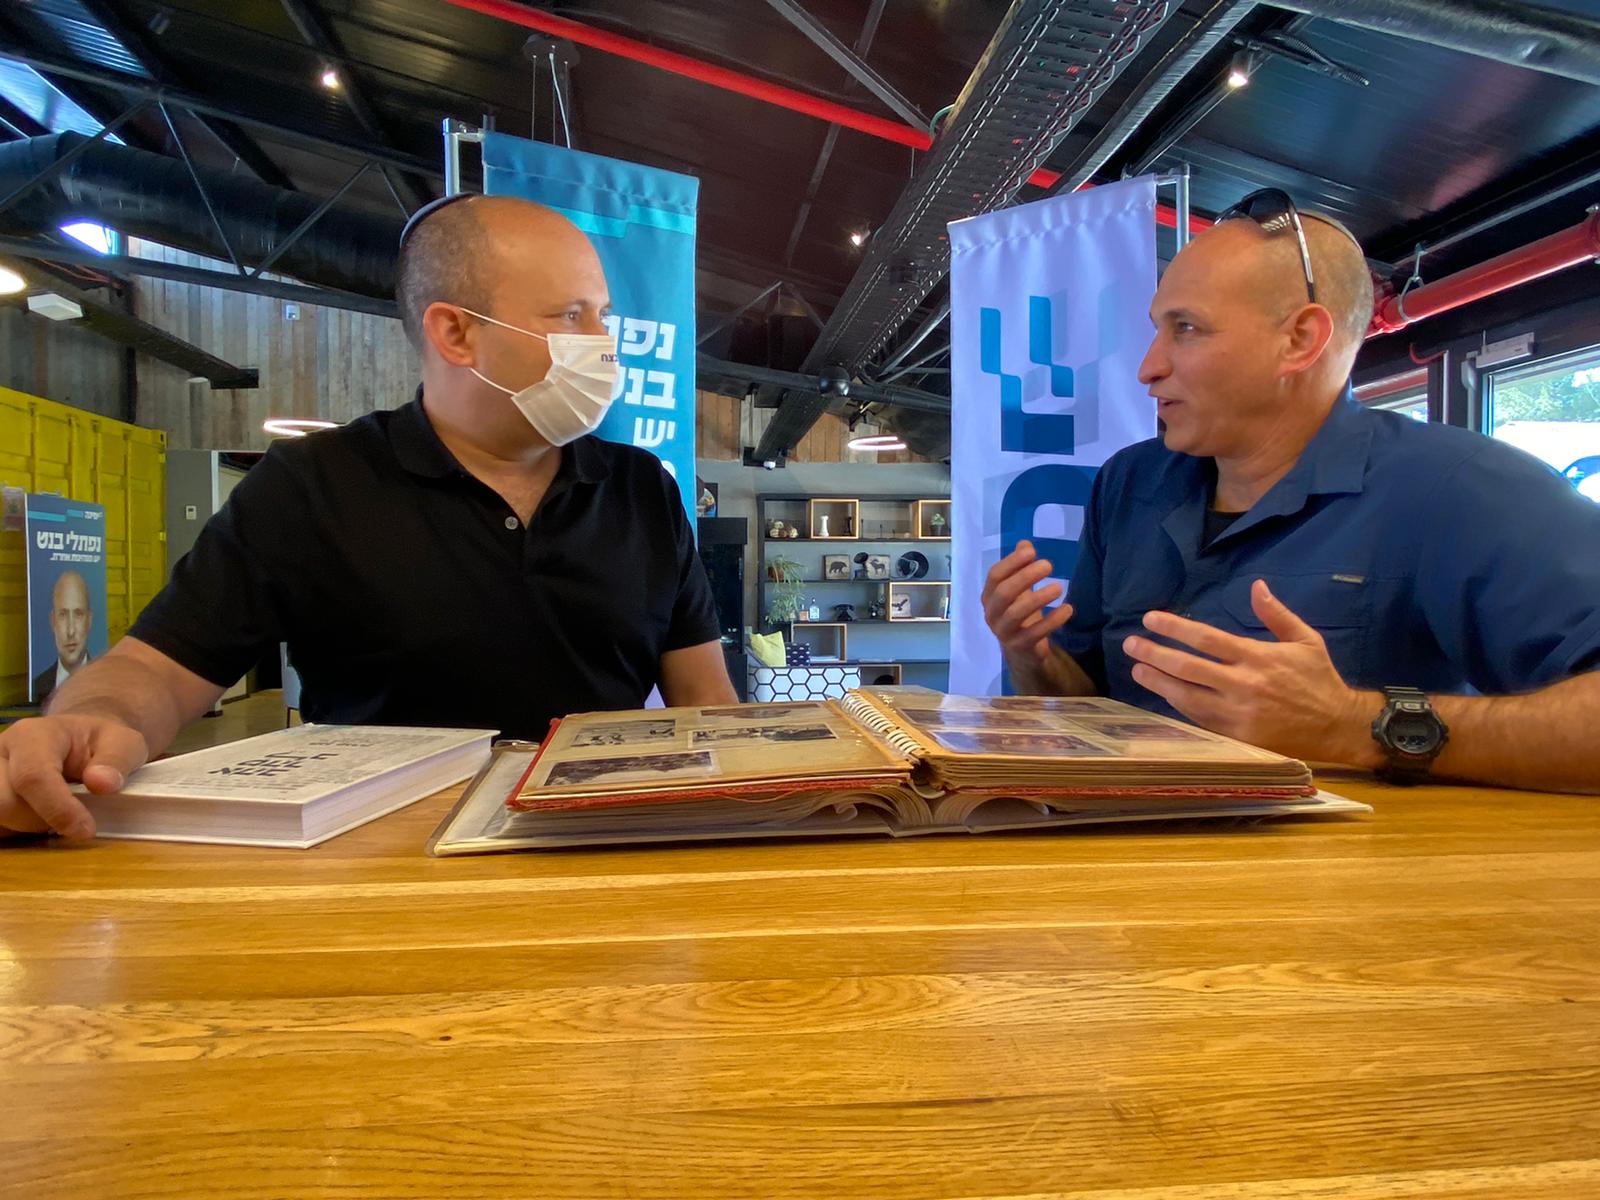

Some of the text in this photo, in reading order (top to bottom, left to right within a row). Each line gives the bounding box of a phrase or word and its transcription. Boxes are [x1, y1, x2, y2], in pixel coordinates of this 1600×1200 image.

[633, 416, 676, 448] יש
[37, 530, 102, 552] נפתלי בנט
